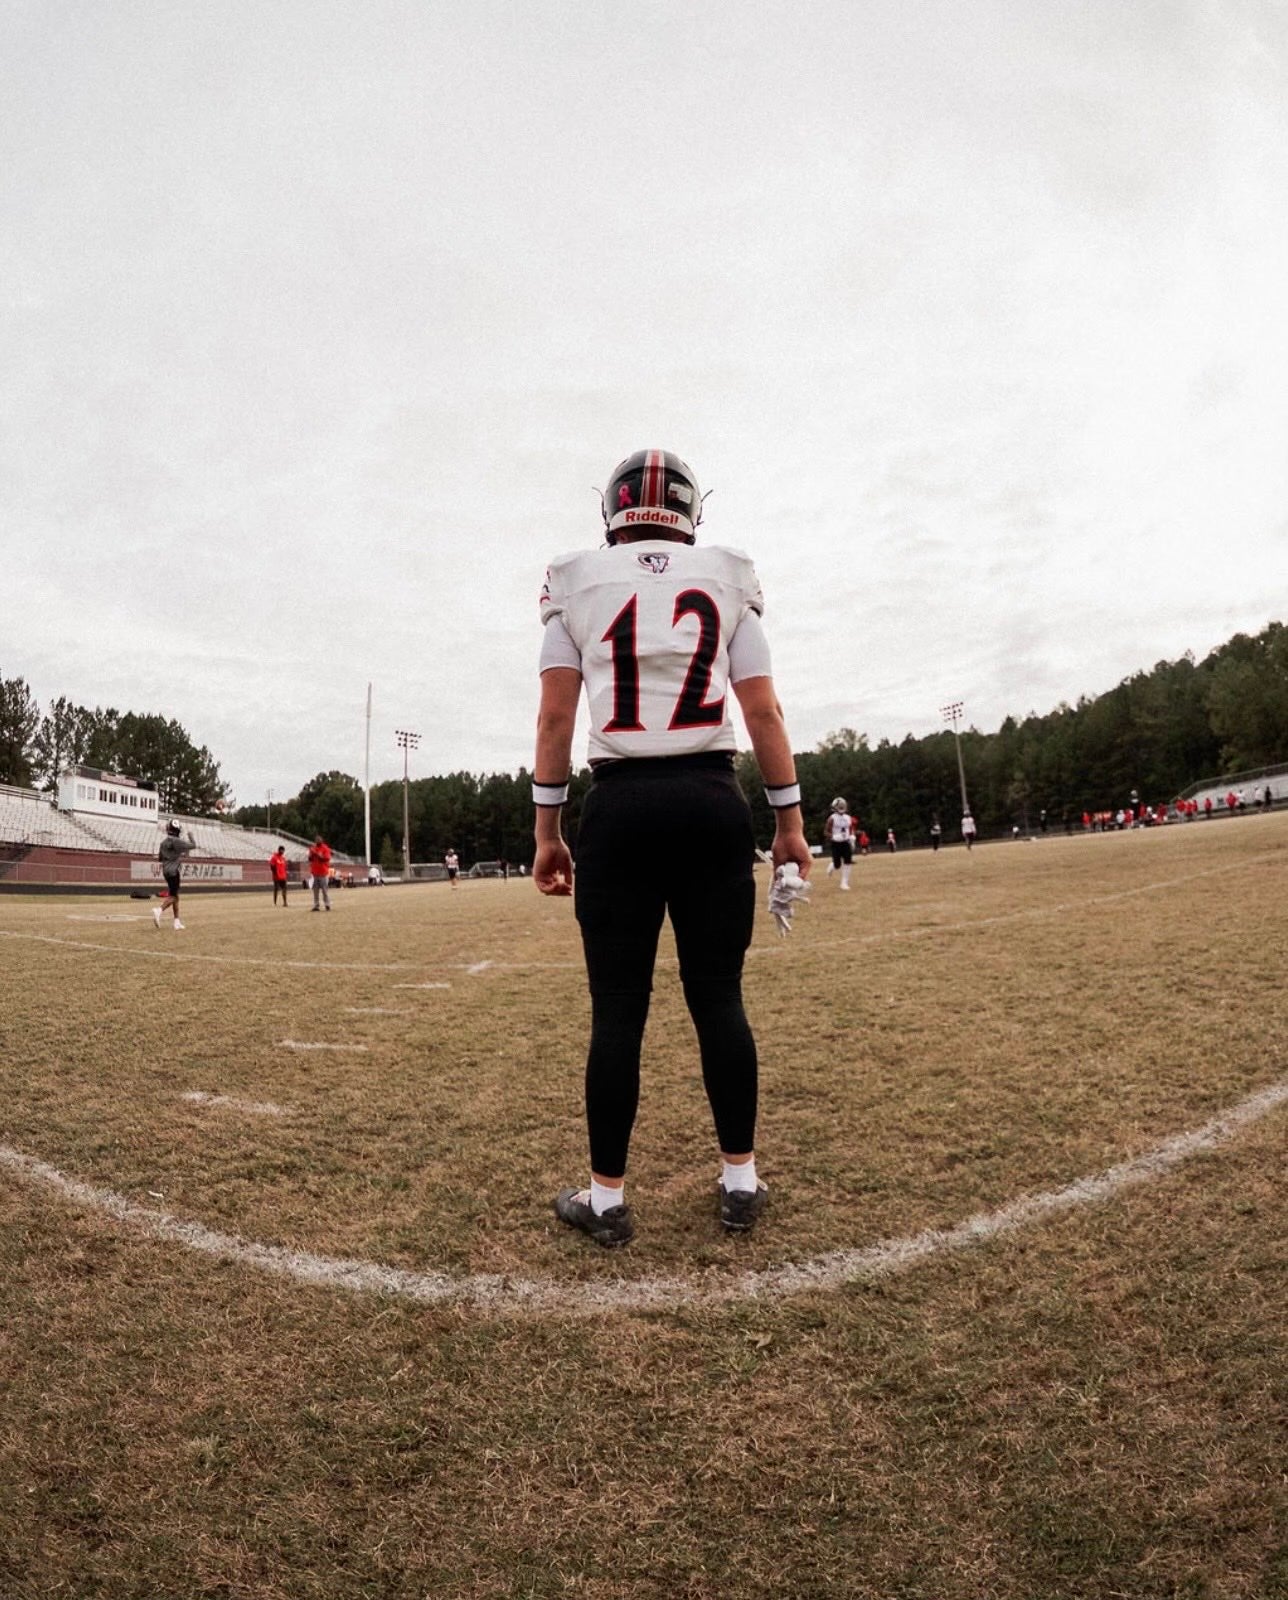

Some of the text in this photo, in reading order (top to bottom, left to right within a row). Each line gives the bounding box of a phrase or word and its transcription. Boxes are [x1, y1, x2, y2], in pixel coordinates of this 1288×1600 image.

[625, 510, 678, 525] Riddell
[601, 588, 725, 732] 12
[151, 863, 223, 877] WERINES
